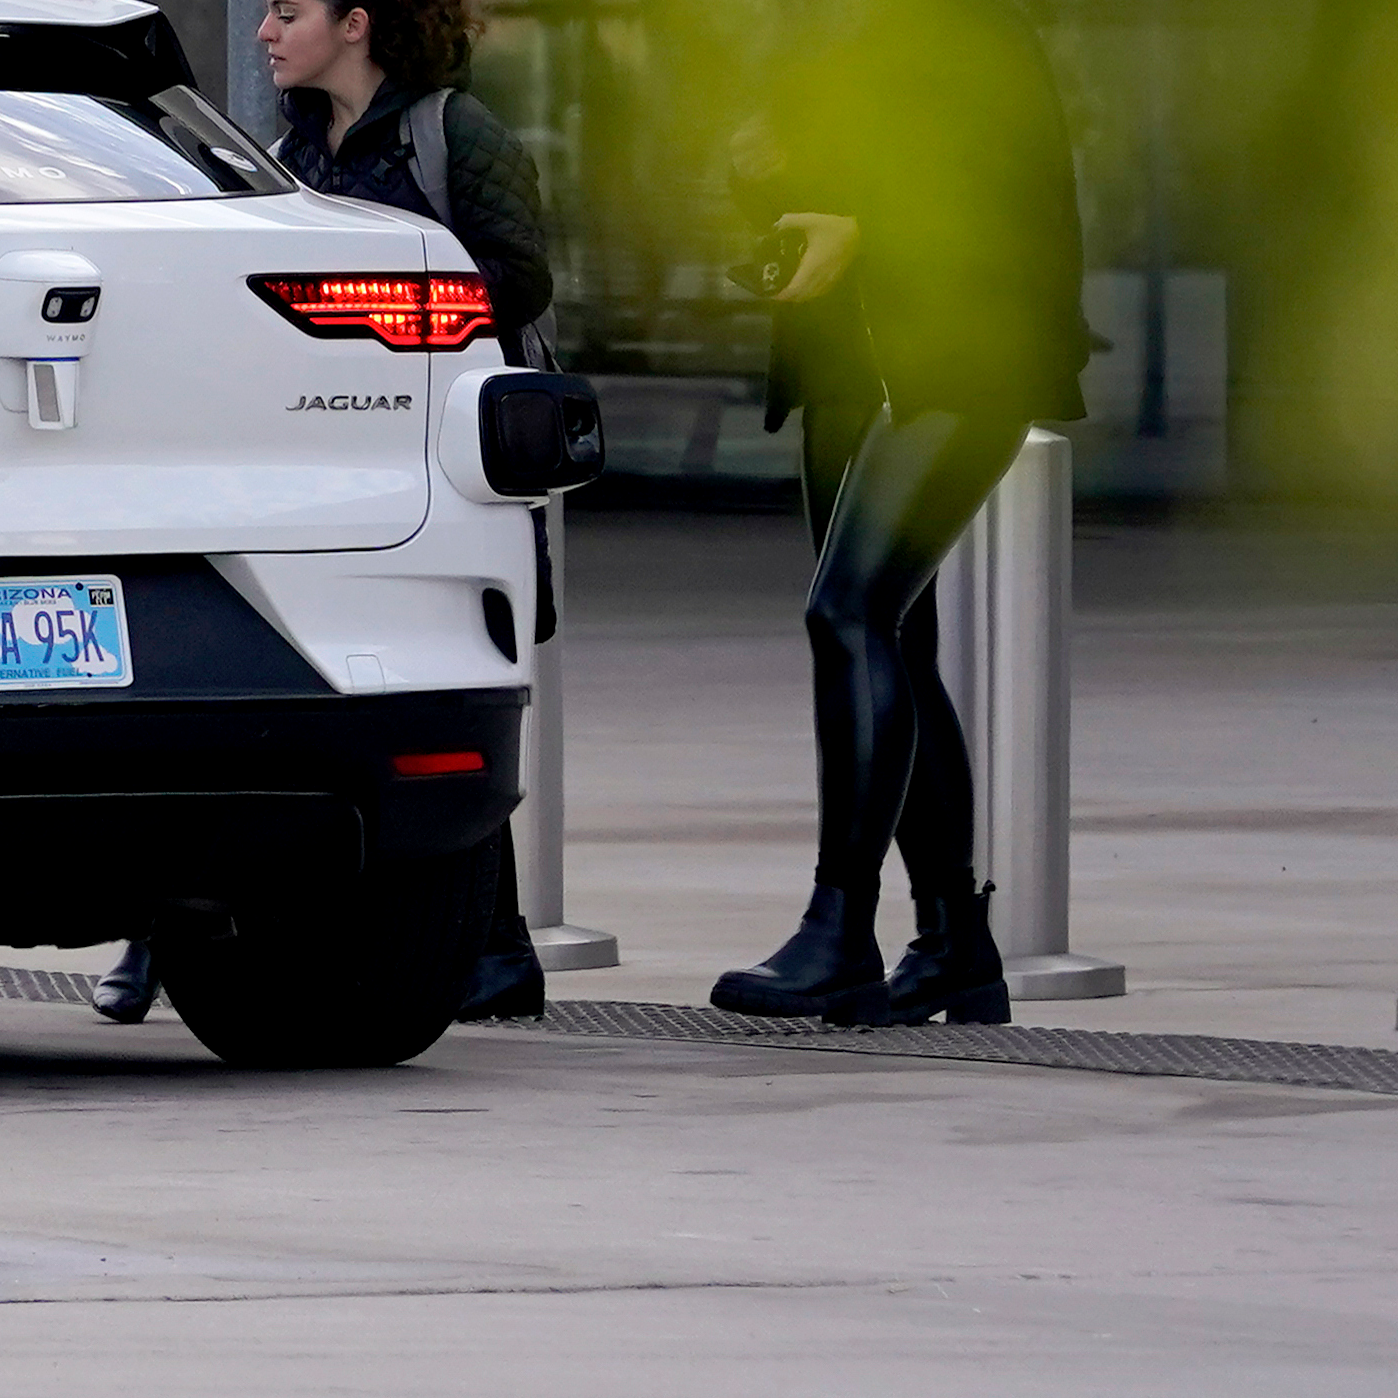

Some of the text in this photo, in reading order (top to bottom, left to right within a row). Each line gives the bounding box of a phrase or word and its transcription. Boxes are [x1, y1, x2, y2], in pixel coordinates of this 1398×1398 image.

[46, 333, 86, 342] WAYMO
[285, 394, 413, 411] JAGUAR
[33, 609, 105, 664] 95K
[55, 666, 84, 679] FUEL
